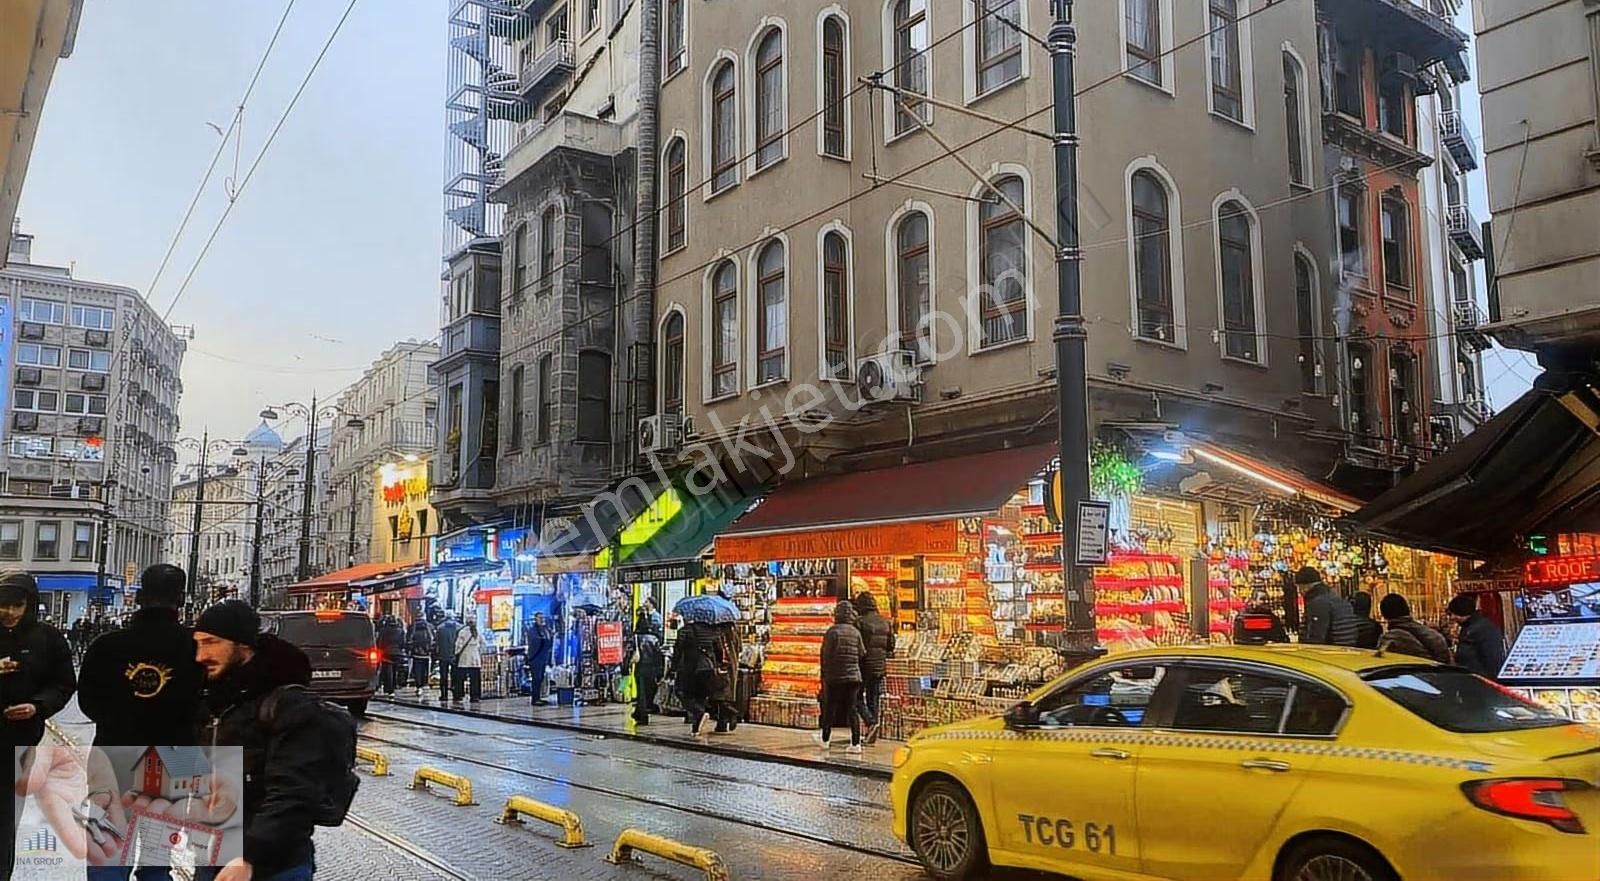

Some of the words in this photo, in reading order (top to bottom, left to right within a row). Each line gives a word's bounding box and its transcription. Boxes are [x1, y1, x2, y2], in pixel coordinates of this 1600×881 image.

[1545, 560, 1592, 579] ROOF
[1017, 813, 1075, 849] TCG
[1085, 821, 1117, 856] 61
